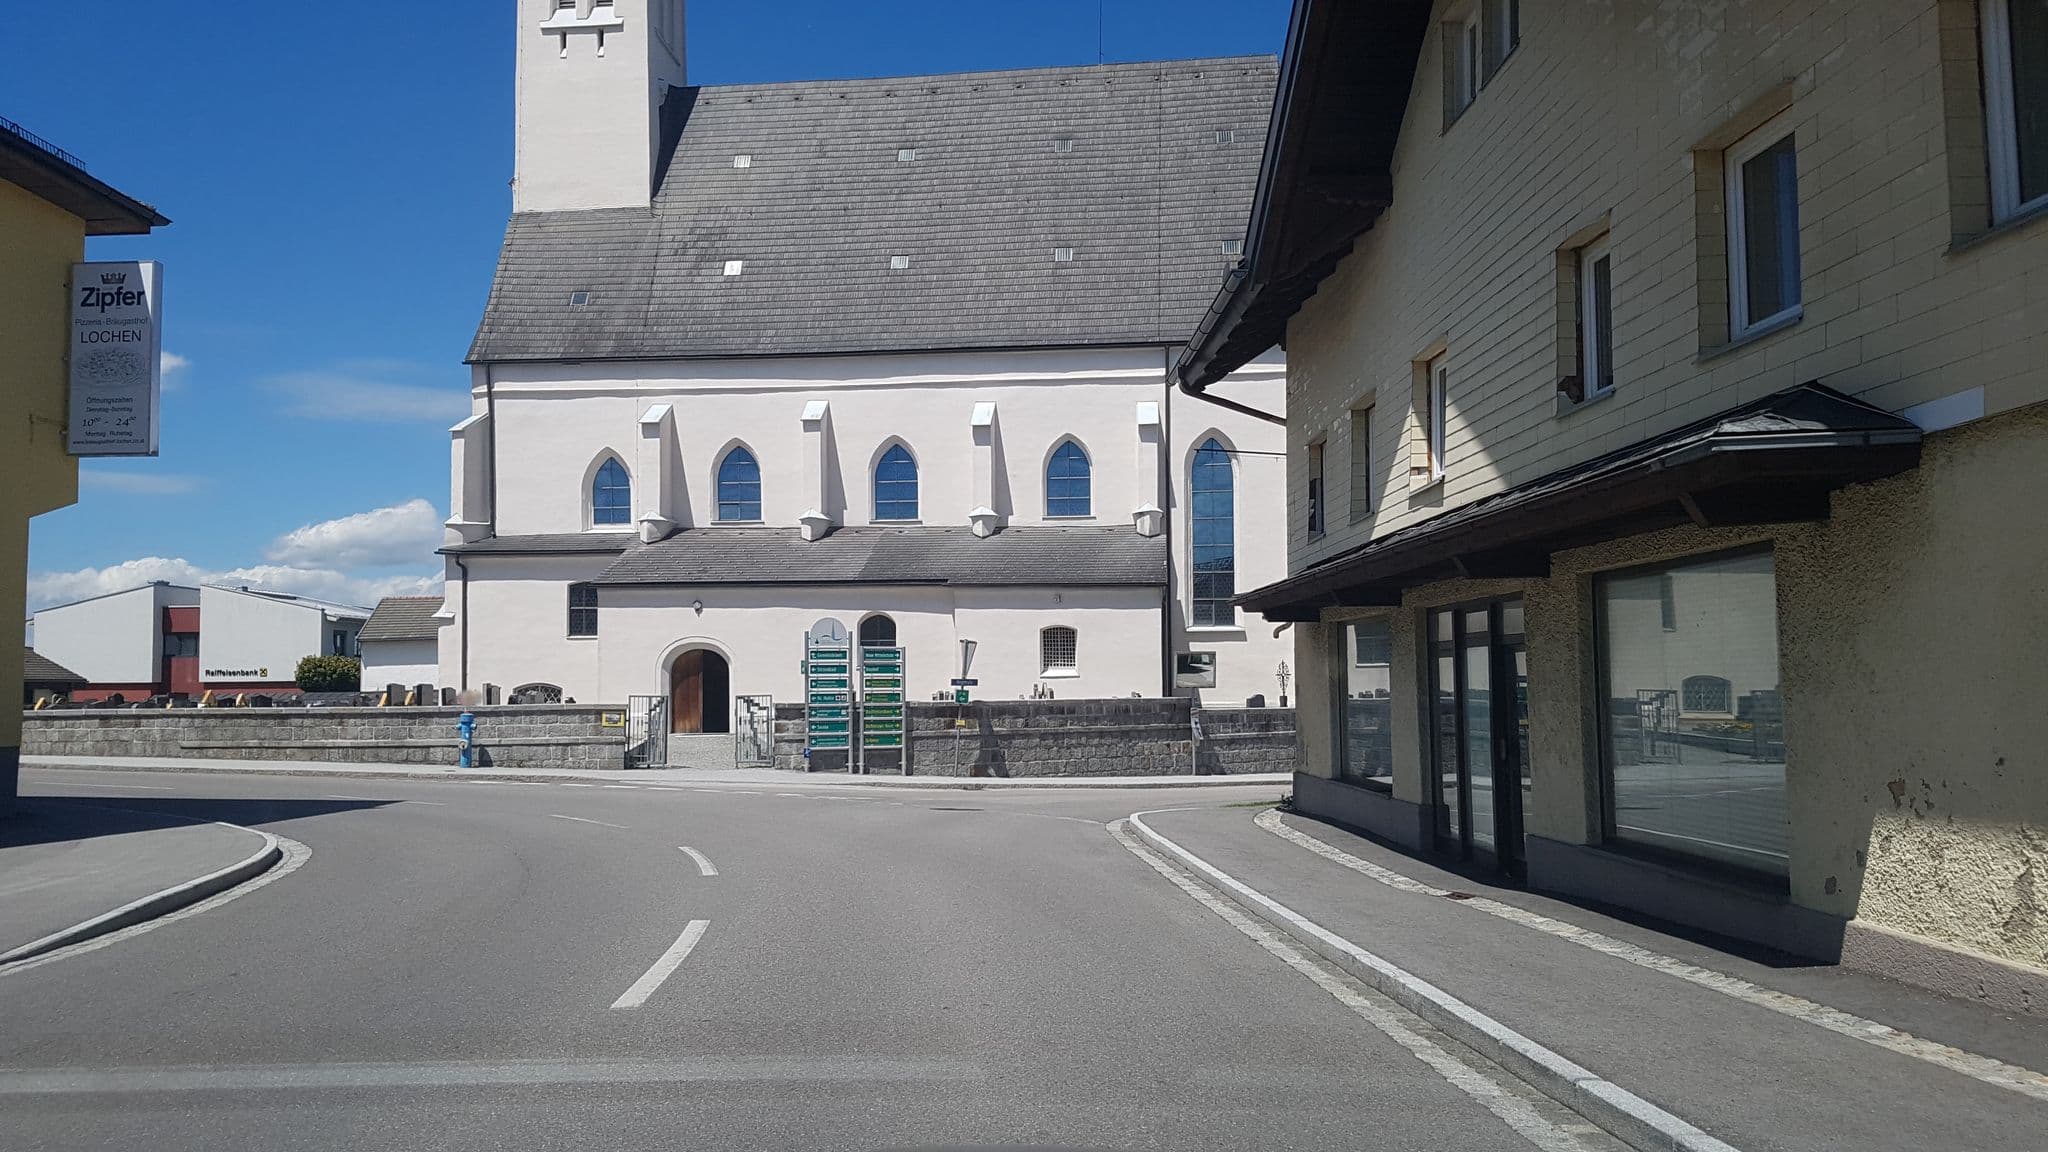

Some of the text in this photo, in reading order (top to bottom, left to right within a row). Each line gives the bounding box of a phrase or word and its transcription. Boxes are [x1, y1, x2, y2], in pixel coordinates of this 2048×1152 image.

[80, 286, 145, 313] Zipfer
[80, 330, 142, 344] LOCHEN
[205, 669, 258, 677] Raiffeisenbank
